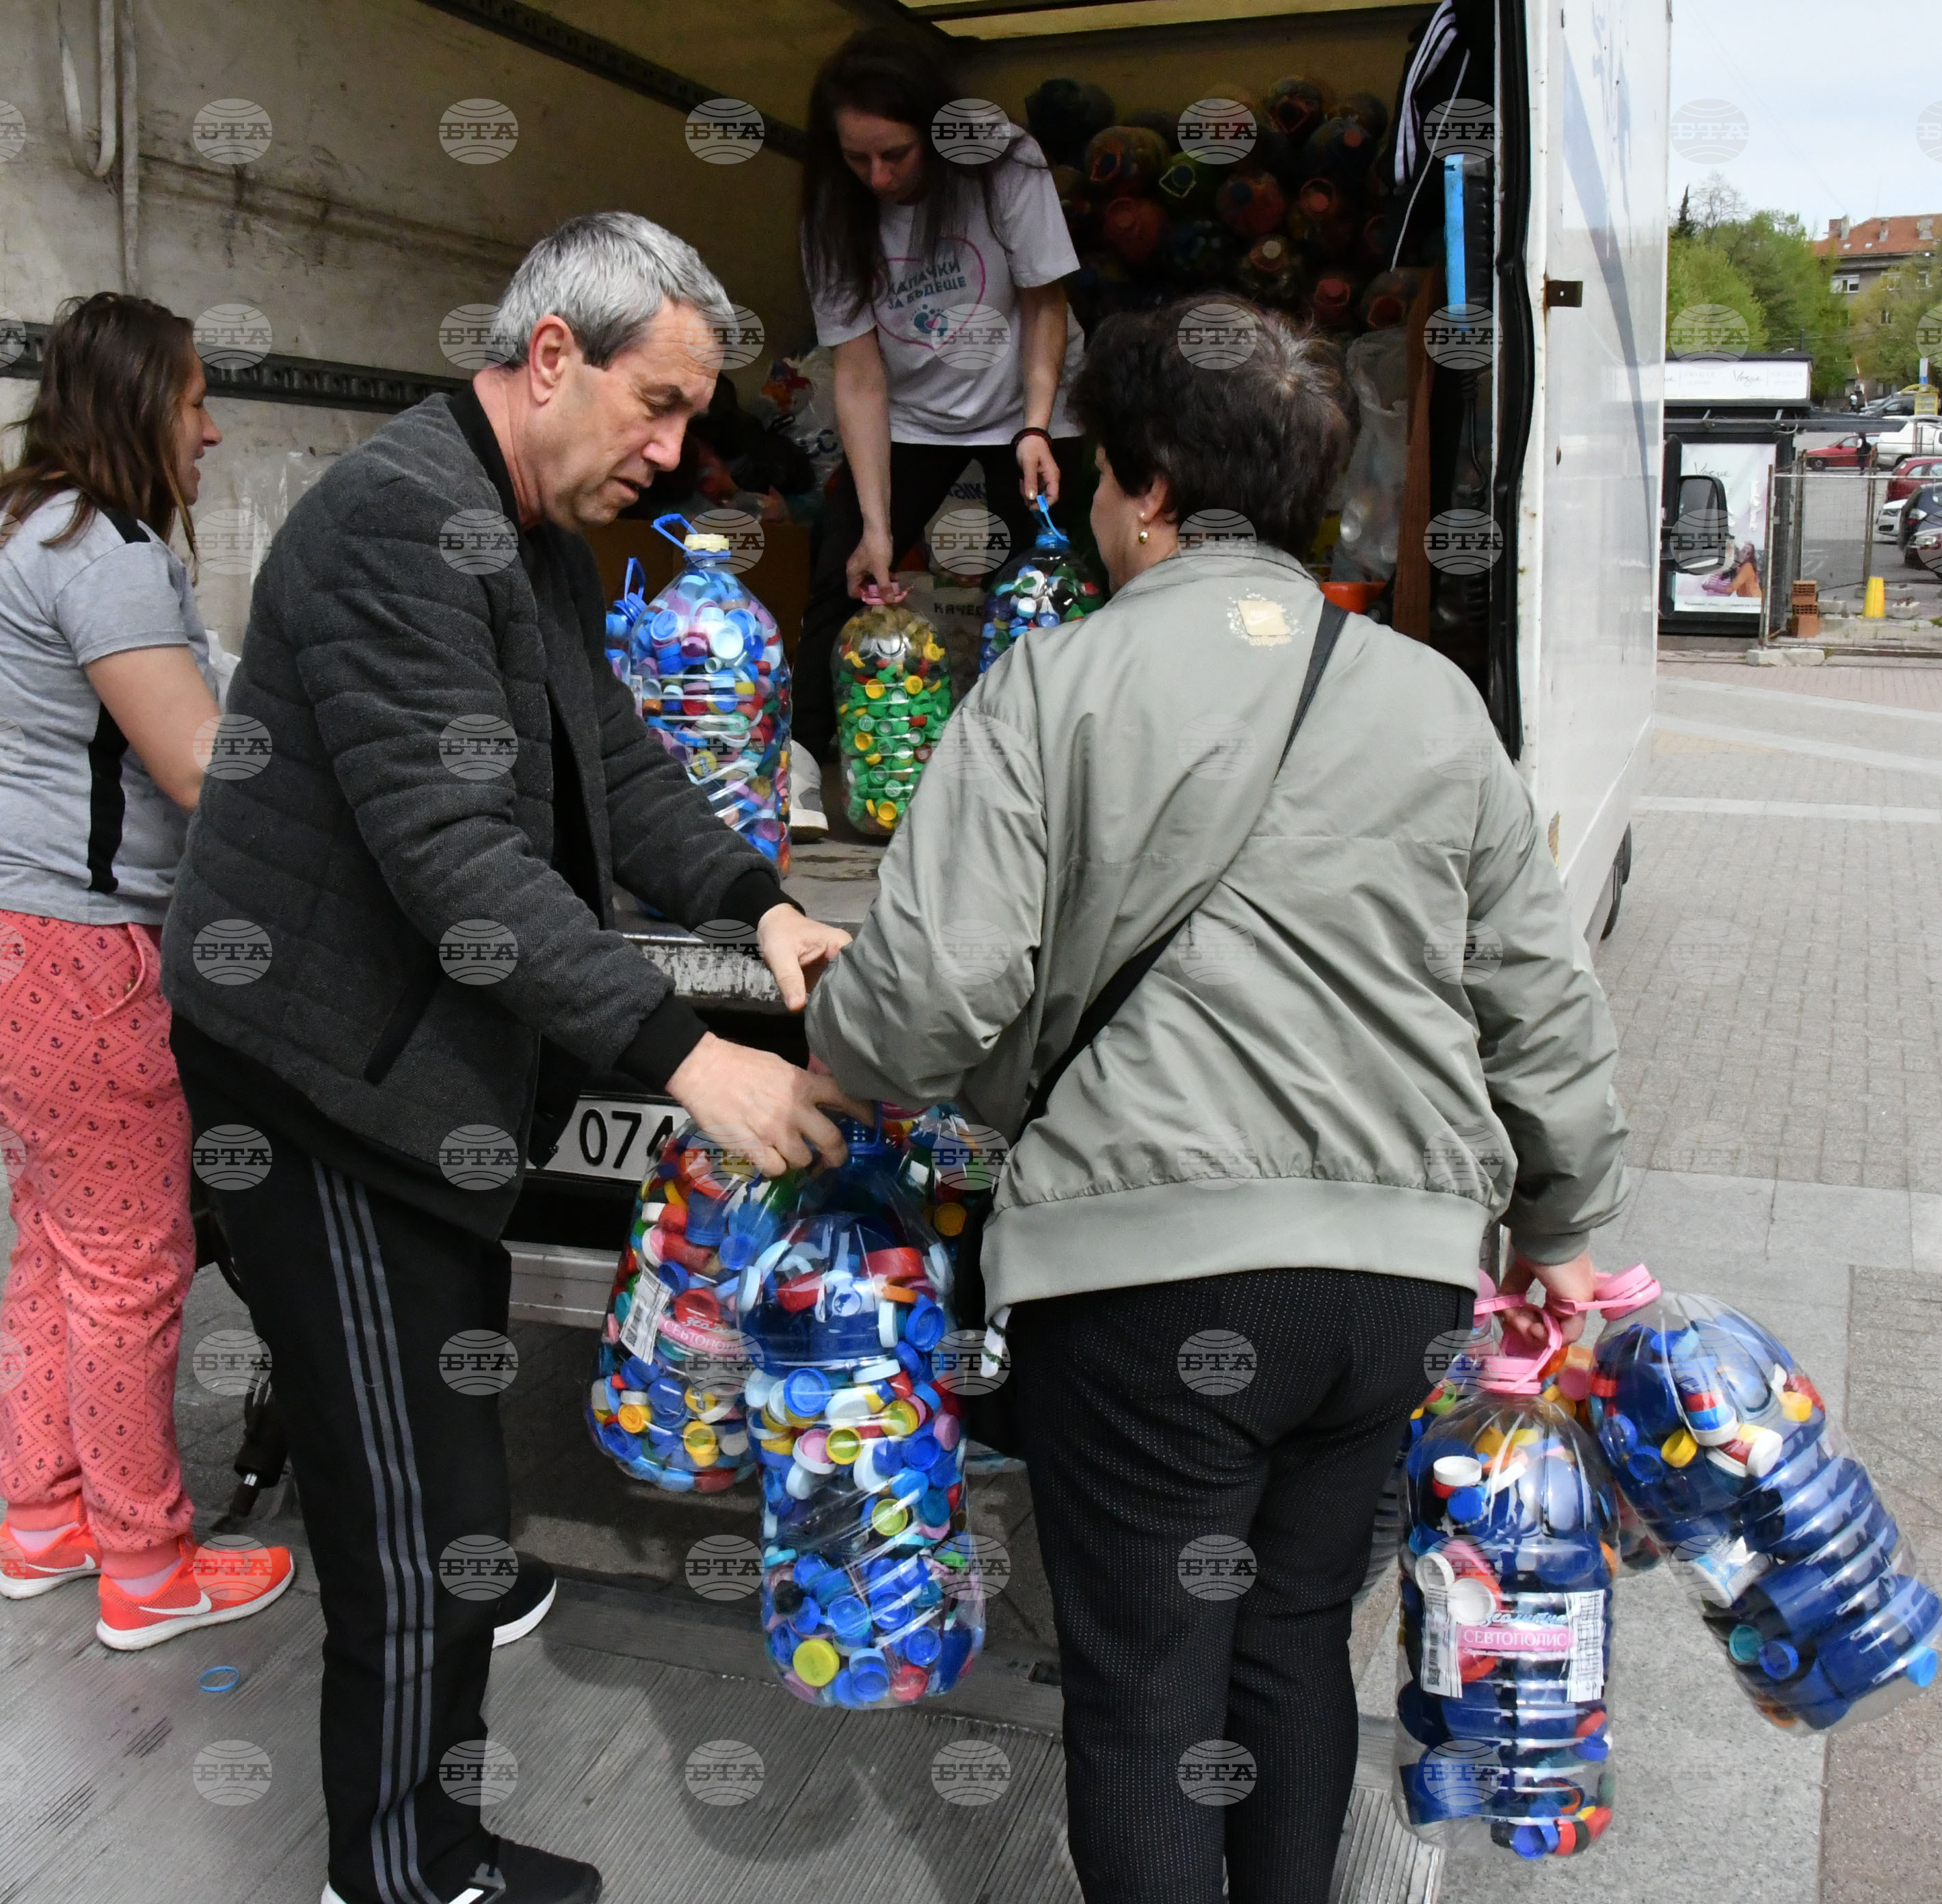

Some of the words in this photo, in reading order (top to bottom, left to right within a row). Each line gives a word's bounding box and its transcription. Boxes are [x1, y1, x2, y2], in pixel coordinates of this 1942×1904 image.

[907, 276, 968, 303] БЪДЕЩЕ
[1733, 369, 1762, 387] Vogue
[1463, 1628, 1567, 1648] СЕВТОПОЛИС
